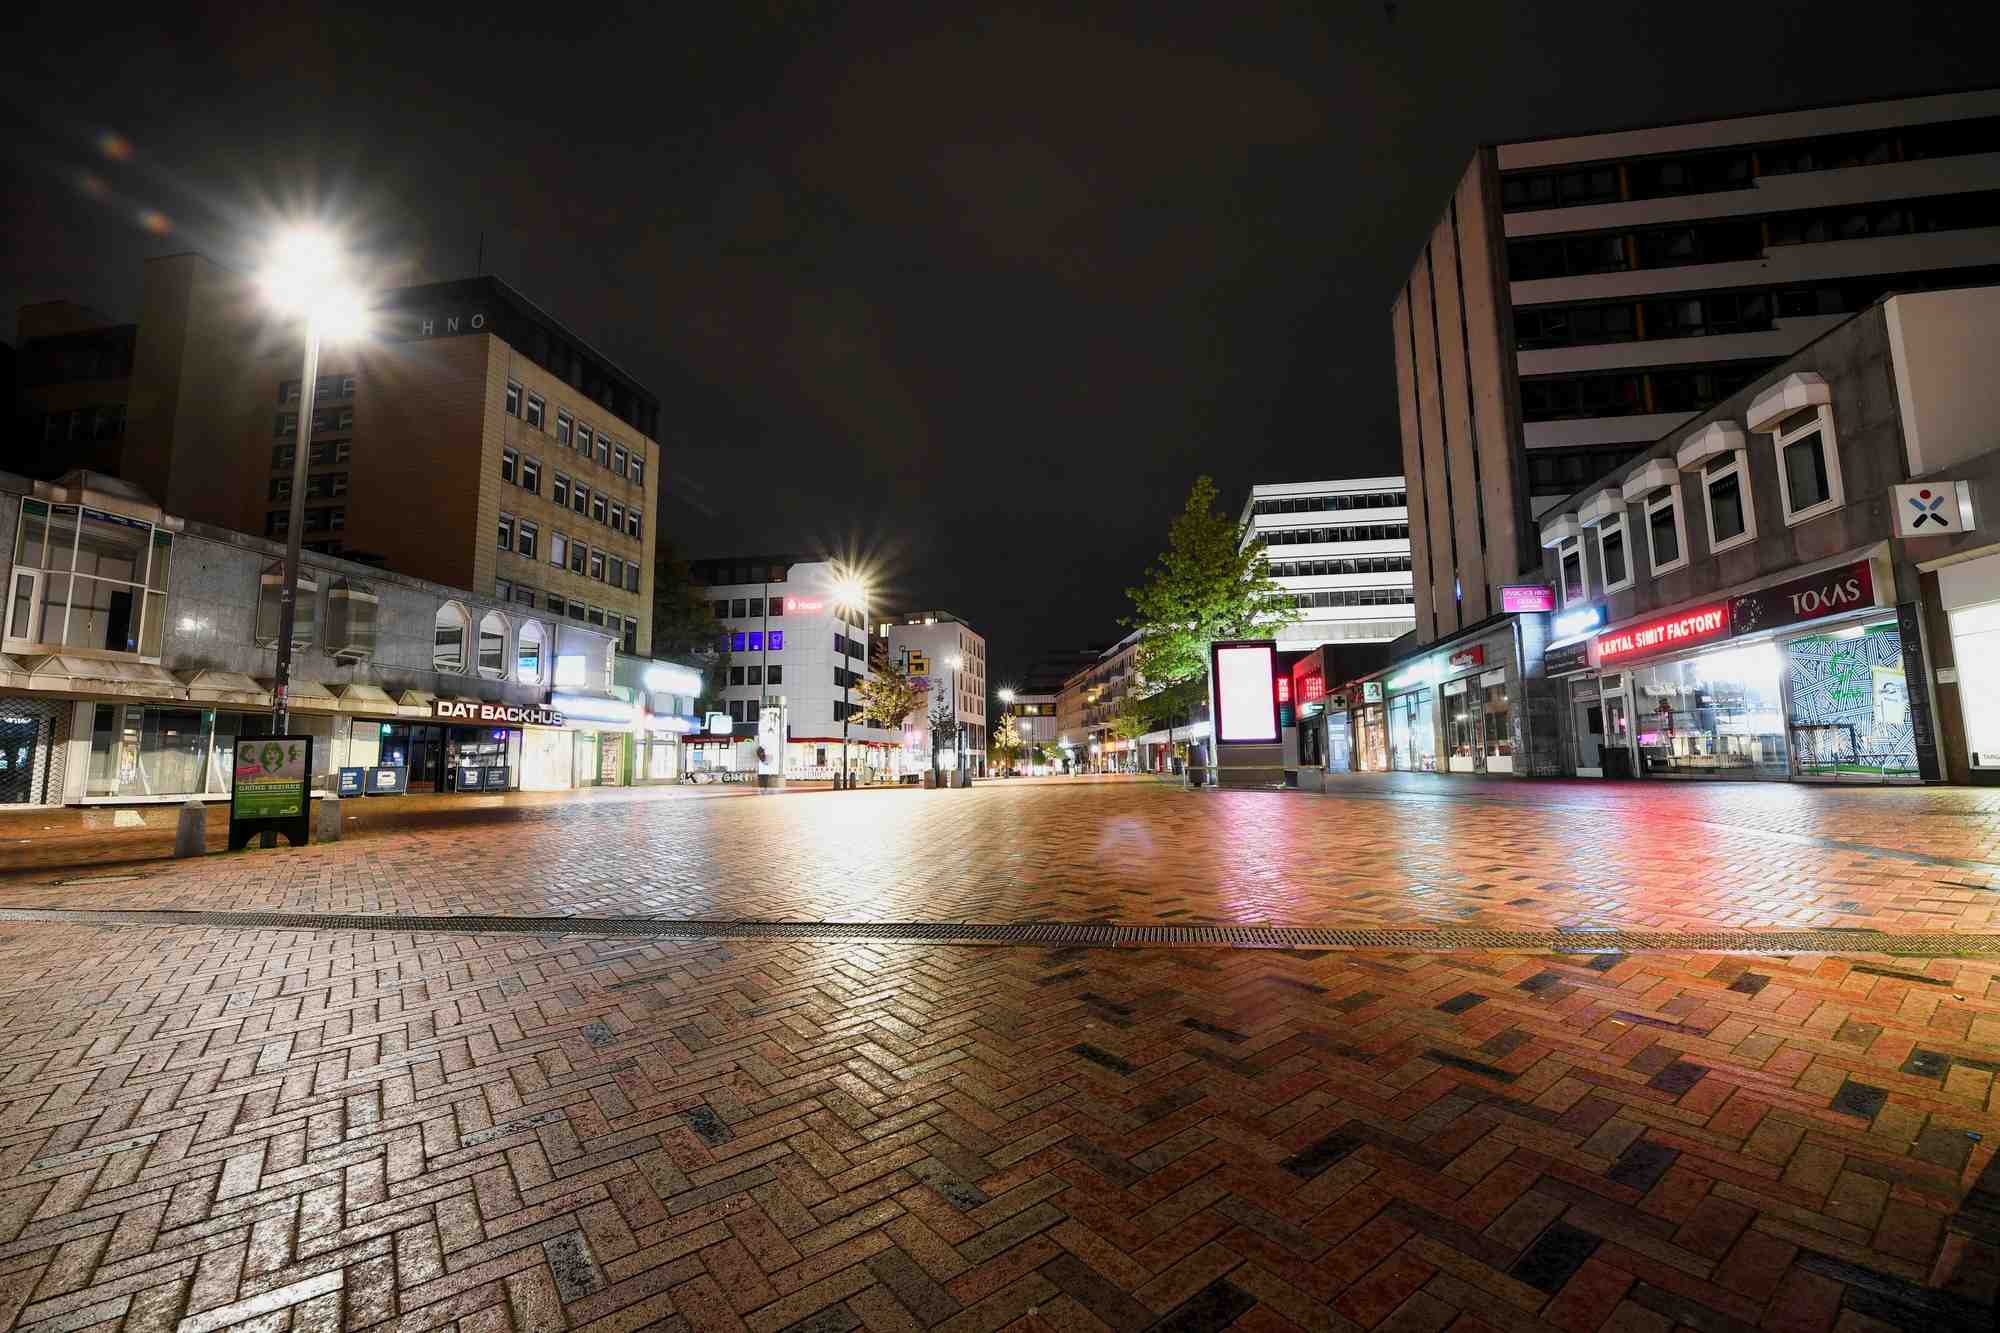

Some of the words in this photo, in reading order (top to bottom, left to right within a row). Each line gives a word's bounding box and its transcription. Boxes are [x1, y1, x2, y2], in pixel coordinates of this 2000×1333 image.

[1598, 635, 1634, 657] KARTAL
[1635, 626, 1665, 649] SIMIT
[1666, 610, 1722, 641] FACTORY
[437, 701, 479, 718] DAT
[480, 704, 563, 726] BACKHUS
